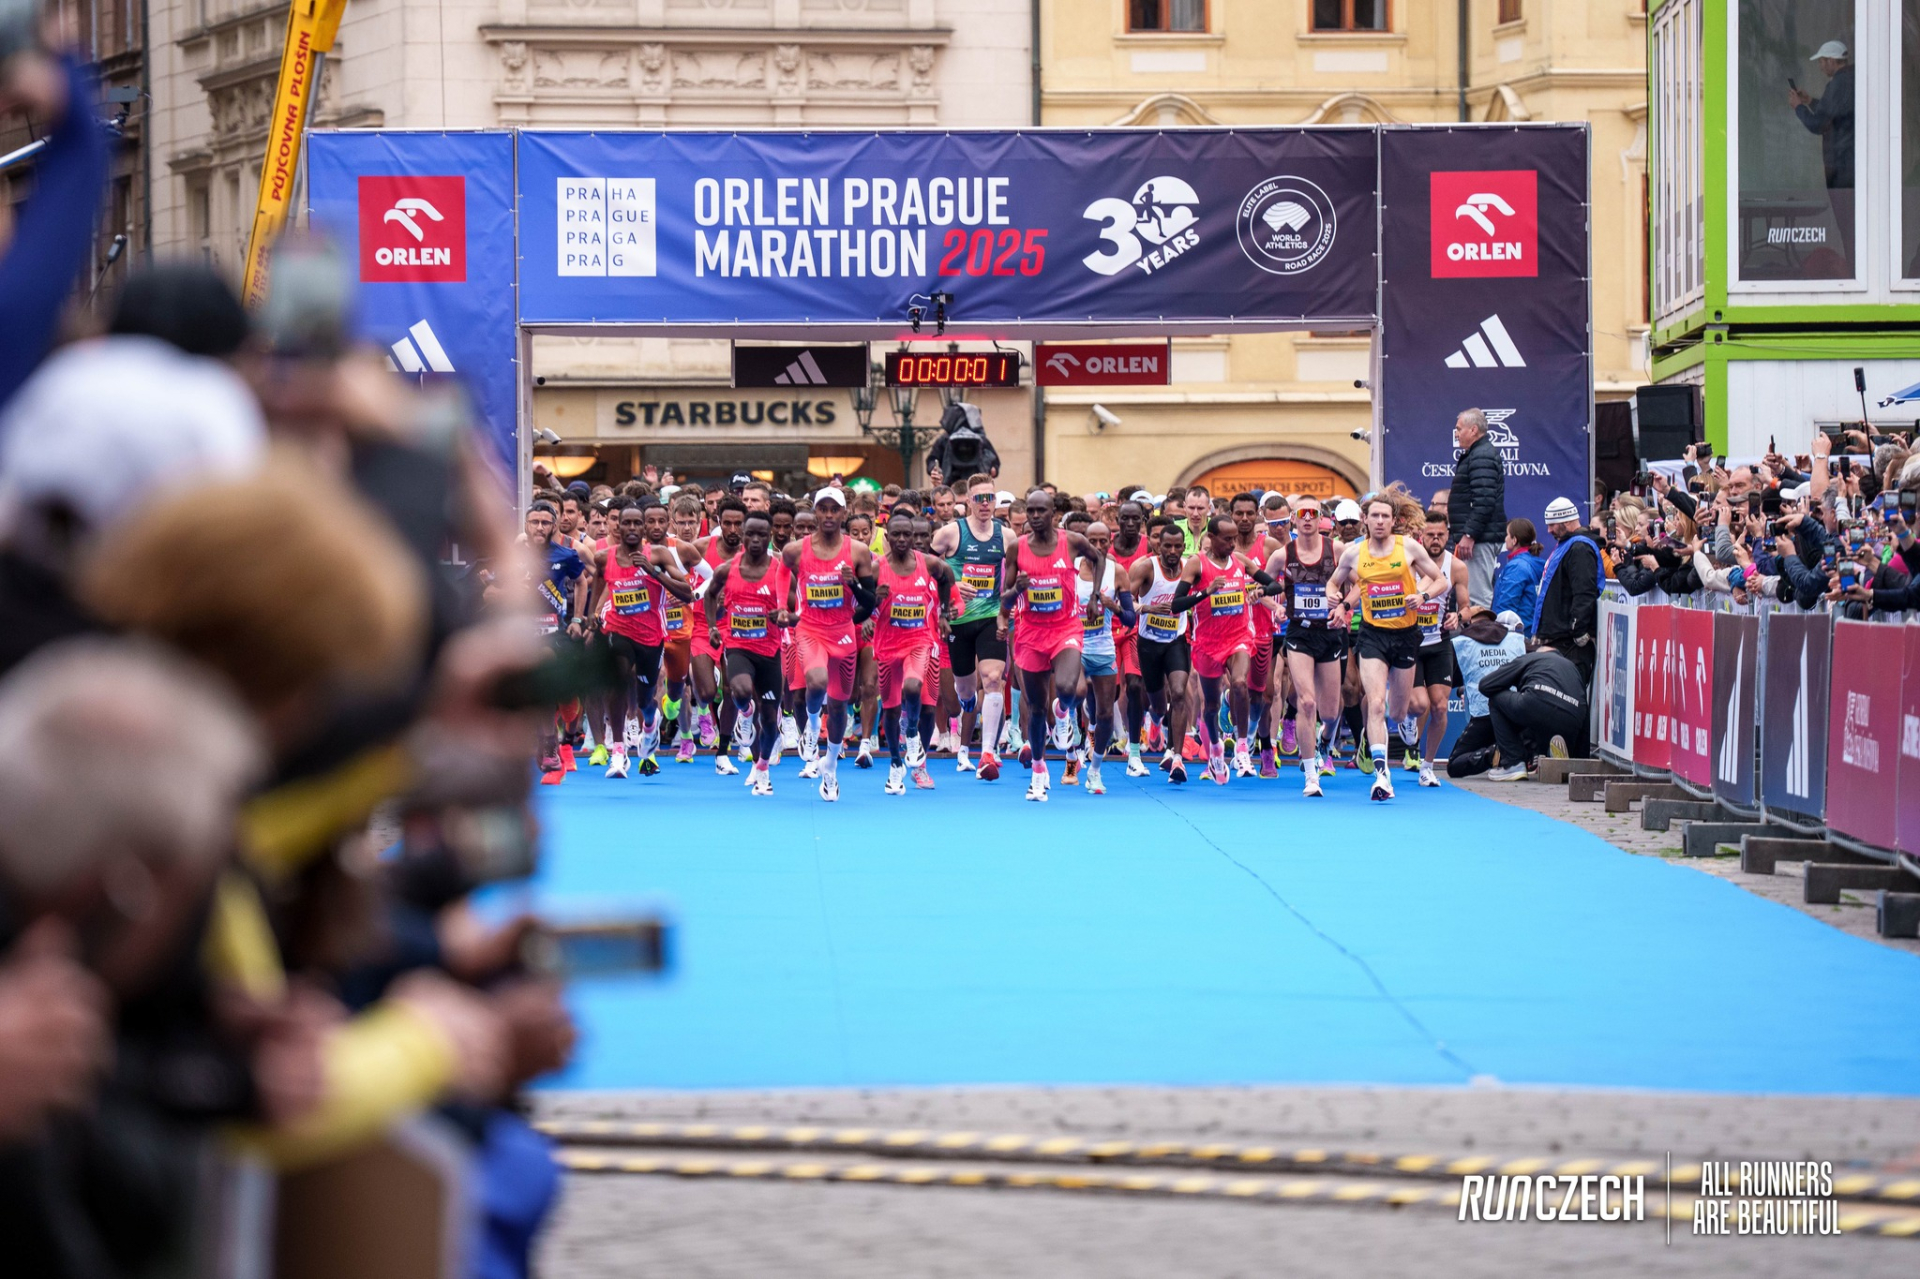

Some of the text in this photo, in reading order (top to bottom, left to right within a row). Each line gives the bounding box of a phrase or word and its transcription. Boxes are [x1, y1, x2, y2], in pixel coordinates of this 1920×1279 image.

[271, 30, 311, 201] PŮJČOVNA PLOŠIN
[566, 187, 636, 200] PRA HA
[694, 177, 1010, 226] ORLEN PRAGUE
[1242, 182, 1278, 218] ELITE LABEL
[566, 210, 649, 222] PRA GUE
[566, 232, 637, 244] PRA GA
[1767, 227, 1826, 243] RUNCZECH
[1265, 241, 1308, 249] ATHLETICS
[1284, 223, 1332, 270] ROAD RACE 2025
[375, 247, 451, 266] ORLEN
[694, 229, 1049, 278] MARATHON 2025
[1136, 228, 1200, 275] YEARS
[1446, 242, 1522, 261] ORLEN
[567, 254, 623, 266] PRA G
[1085, 356, 1158, 374] ORLEN
[615, 401, 836, 426] STARBUCKS
[1422, 462, 1456, 477] ČESK
[1294, 481, 1325, 493] SPOT
[623, 579, 643, 587] ORLEN
[1038, 577, 1058, 585] ORLEN
[810, 588, 839, 598] TARIKU
[1381, 584, 1400, 592] ORLEN
[615, 591, 647, 604] PACE M1
[1033, 592, 1056, 601] MARK
[1214, 595, 1241, 606] KELKILE
[1303, 598, 1320, 608] 109
[1372, 597, 1404, 609] ANDREW
[892, 607, 924, 618] PACE W1
[732, 618, 765, 627] PACE M2
[1150, 616, 1176, 629] GADISA
[1417, 616, 1434, 624] IRKA
[1480, 649, 1507, 657] MEDIA
[1447, 699, 1465, 712] CZE
